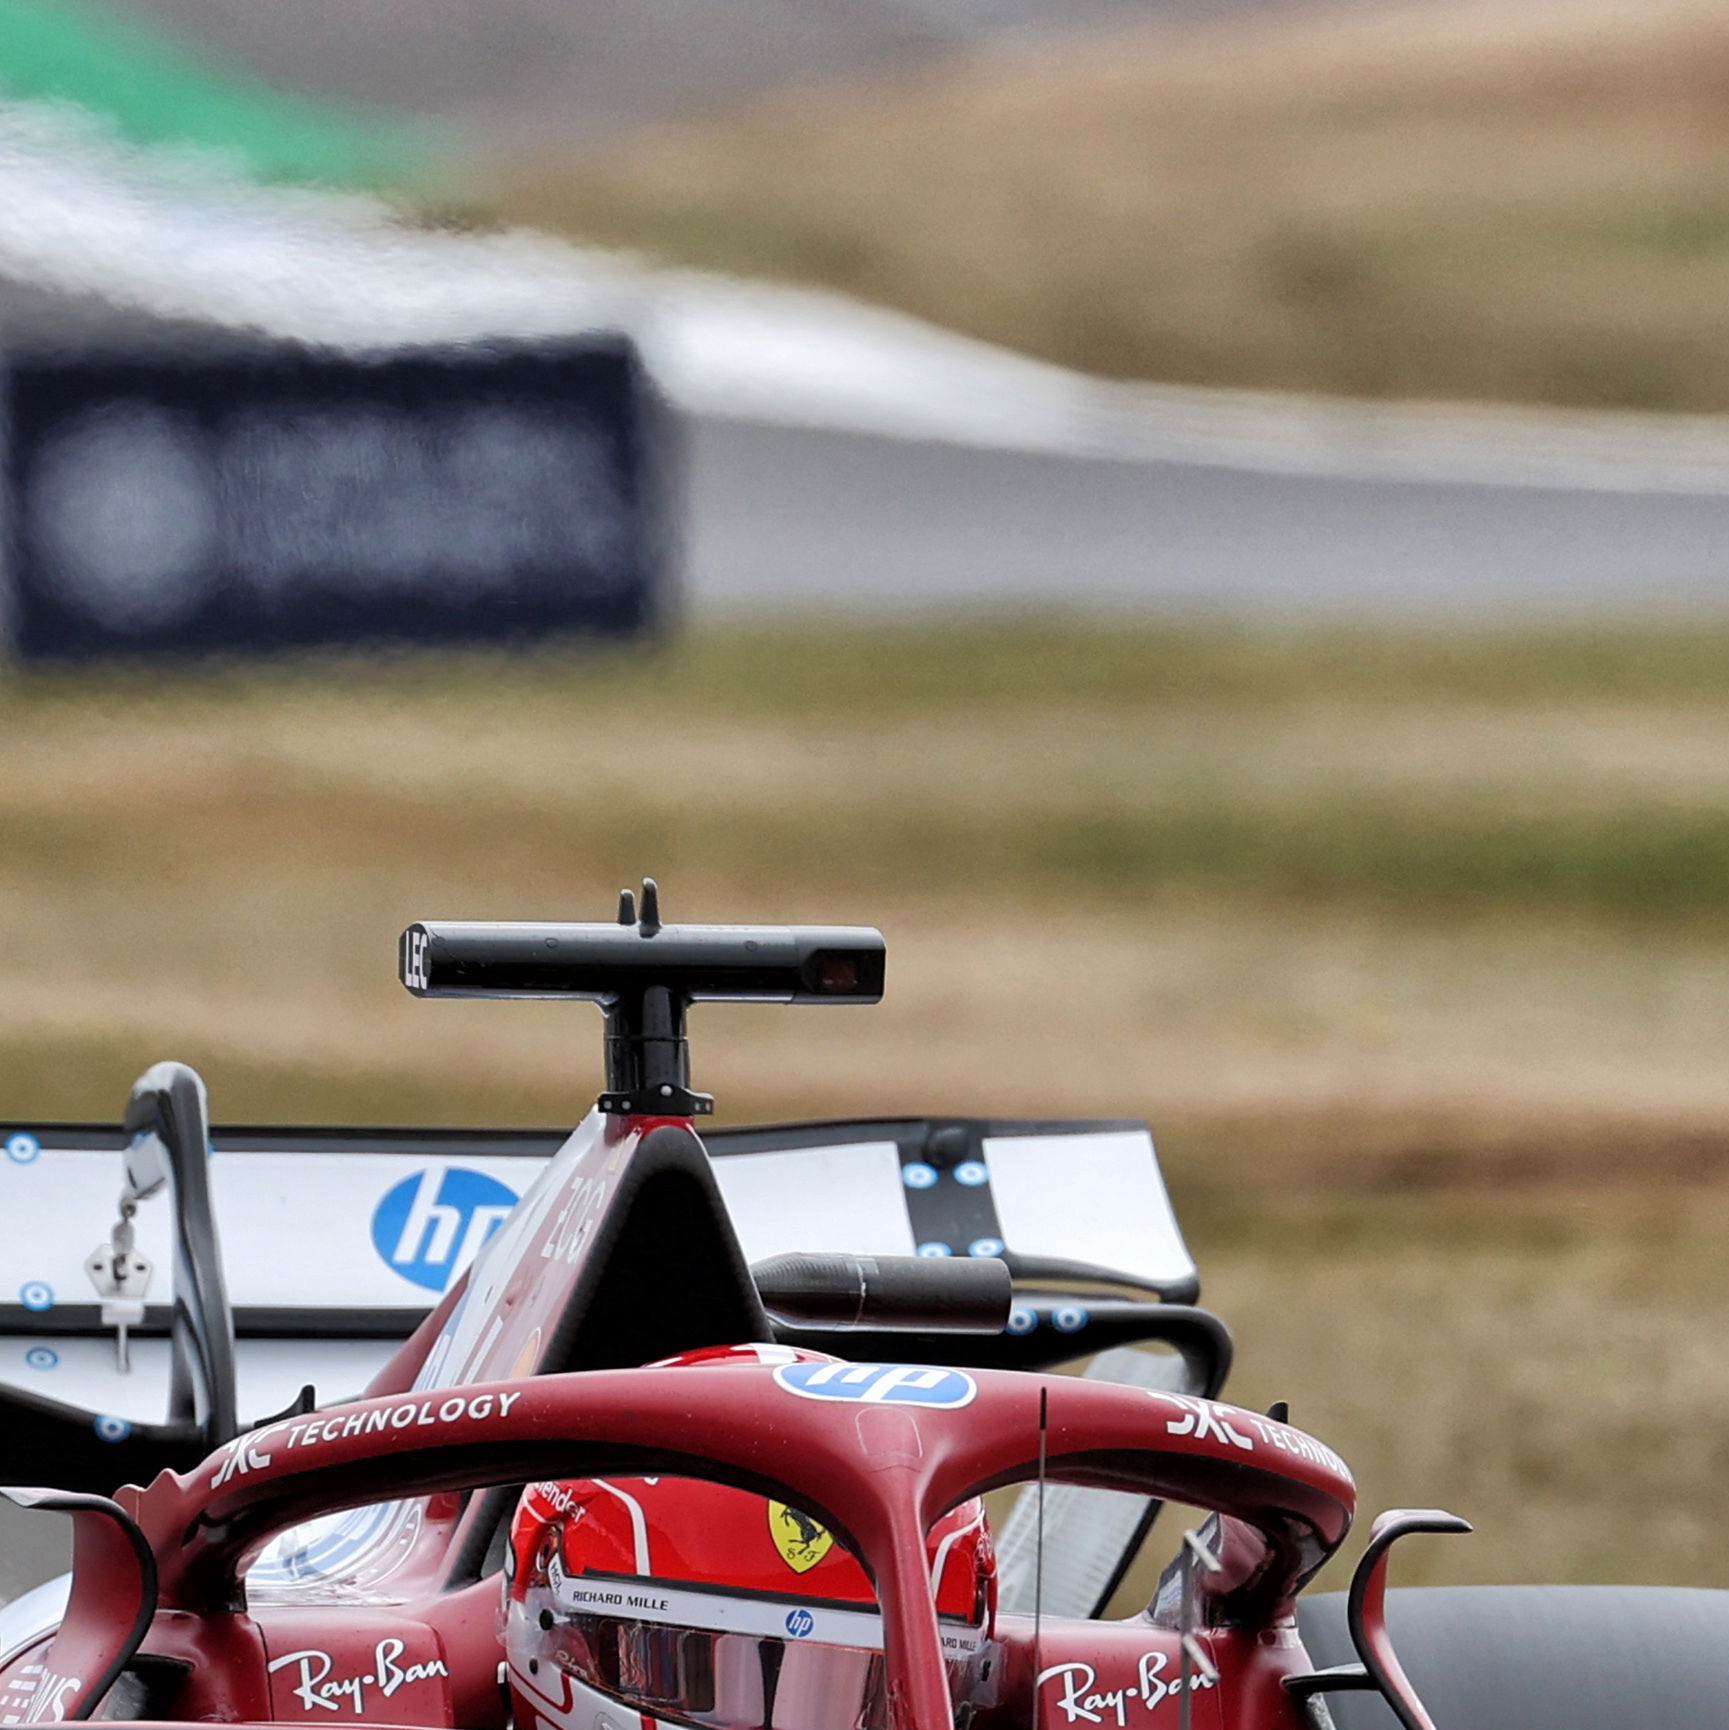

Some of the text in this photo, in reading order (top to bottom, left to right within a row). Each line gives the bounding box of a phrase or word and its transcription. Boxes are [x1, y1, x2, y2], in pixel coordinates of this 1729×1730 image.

[405, 930, 428, 990] LEC
[286, 1392, 521, 1450] TECHNOLOGY
[573, 1590, 669, 1611] RICHARD MILLE
[787, 1608, 814, 1637] hp
